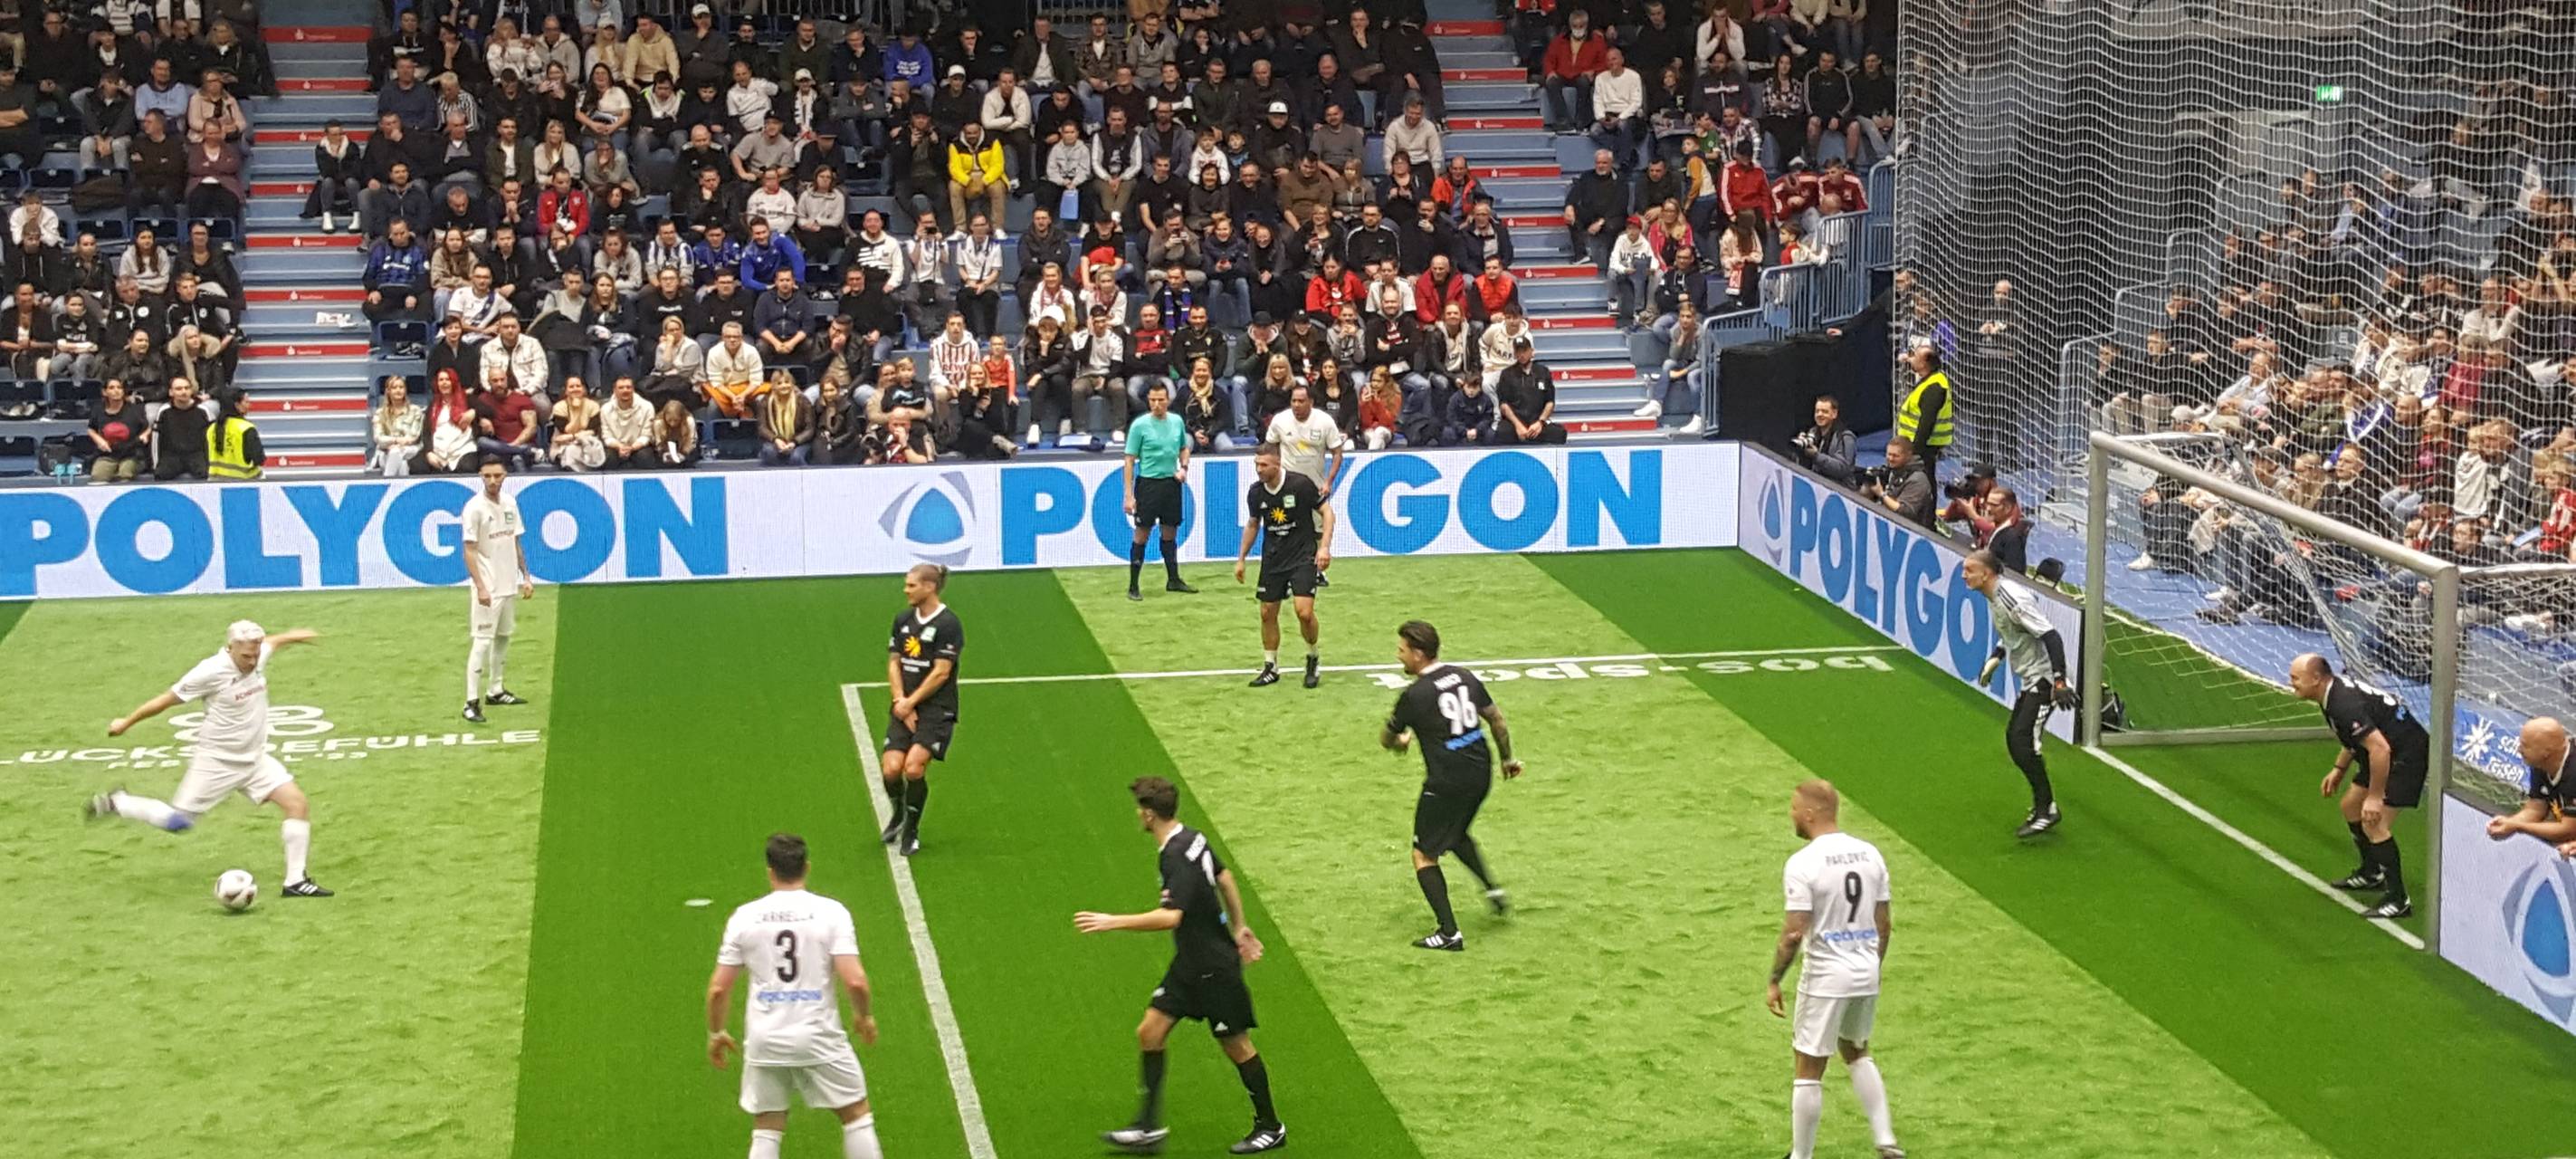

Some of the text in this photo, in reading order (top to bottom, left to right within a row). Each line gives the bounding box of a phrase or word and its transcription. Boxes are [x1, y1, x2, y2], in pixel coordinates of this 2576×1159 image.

[1000, 450, 1664, 565] POLGON
[0, 477, 729, 599] POLYGON
[1438, 685, 1478, 735] 96
[0, 730, 541, 764] ÜCKEFÜHLE
[1845, 870, 1863, 924] 9
[776, 929, 797, 983] 3
